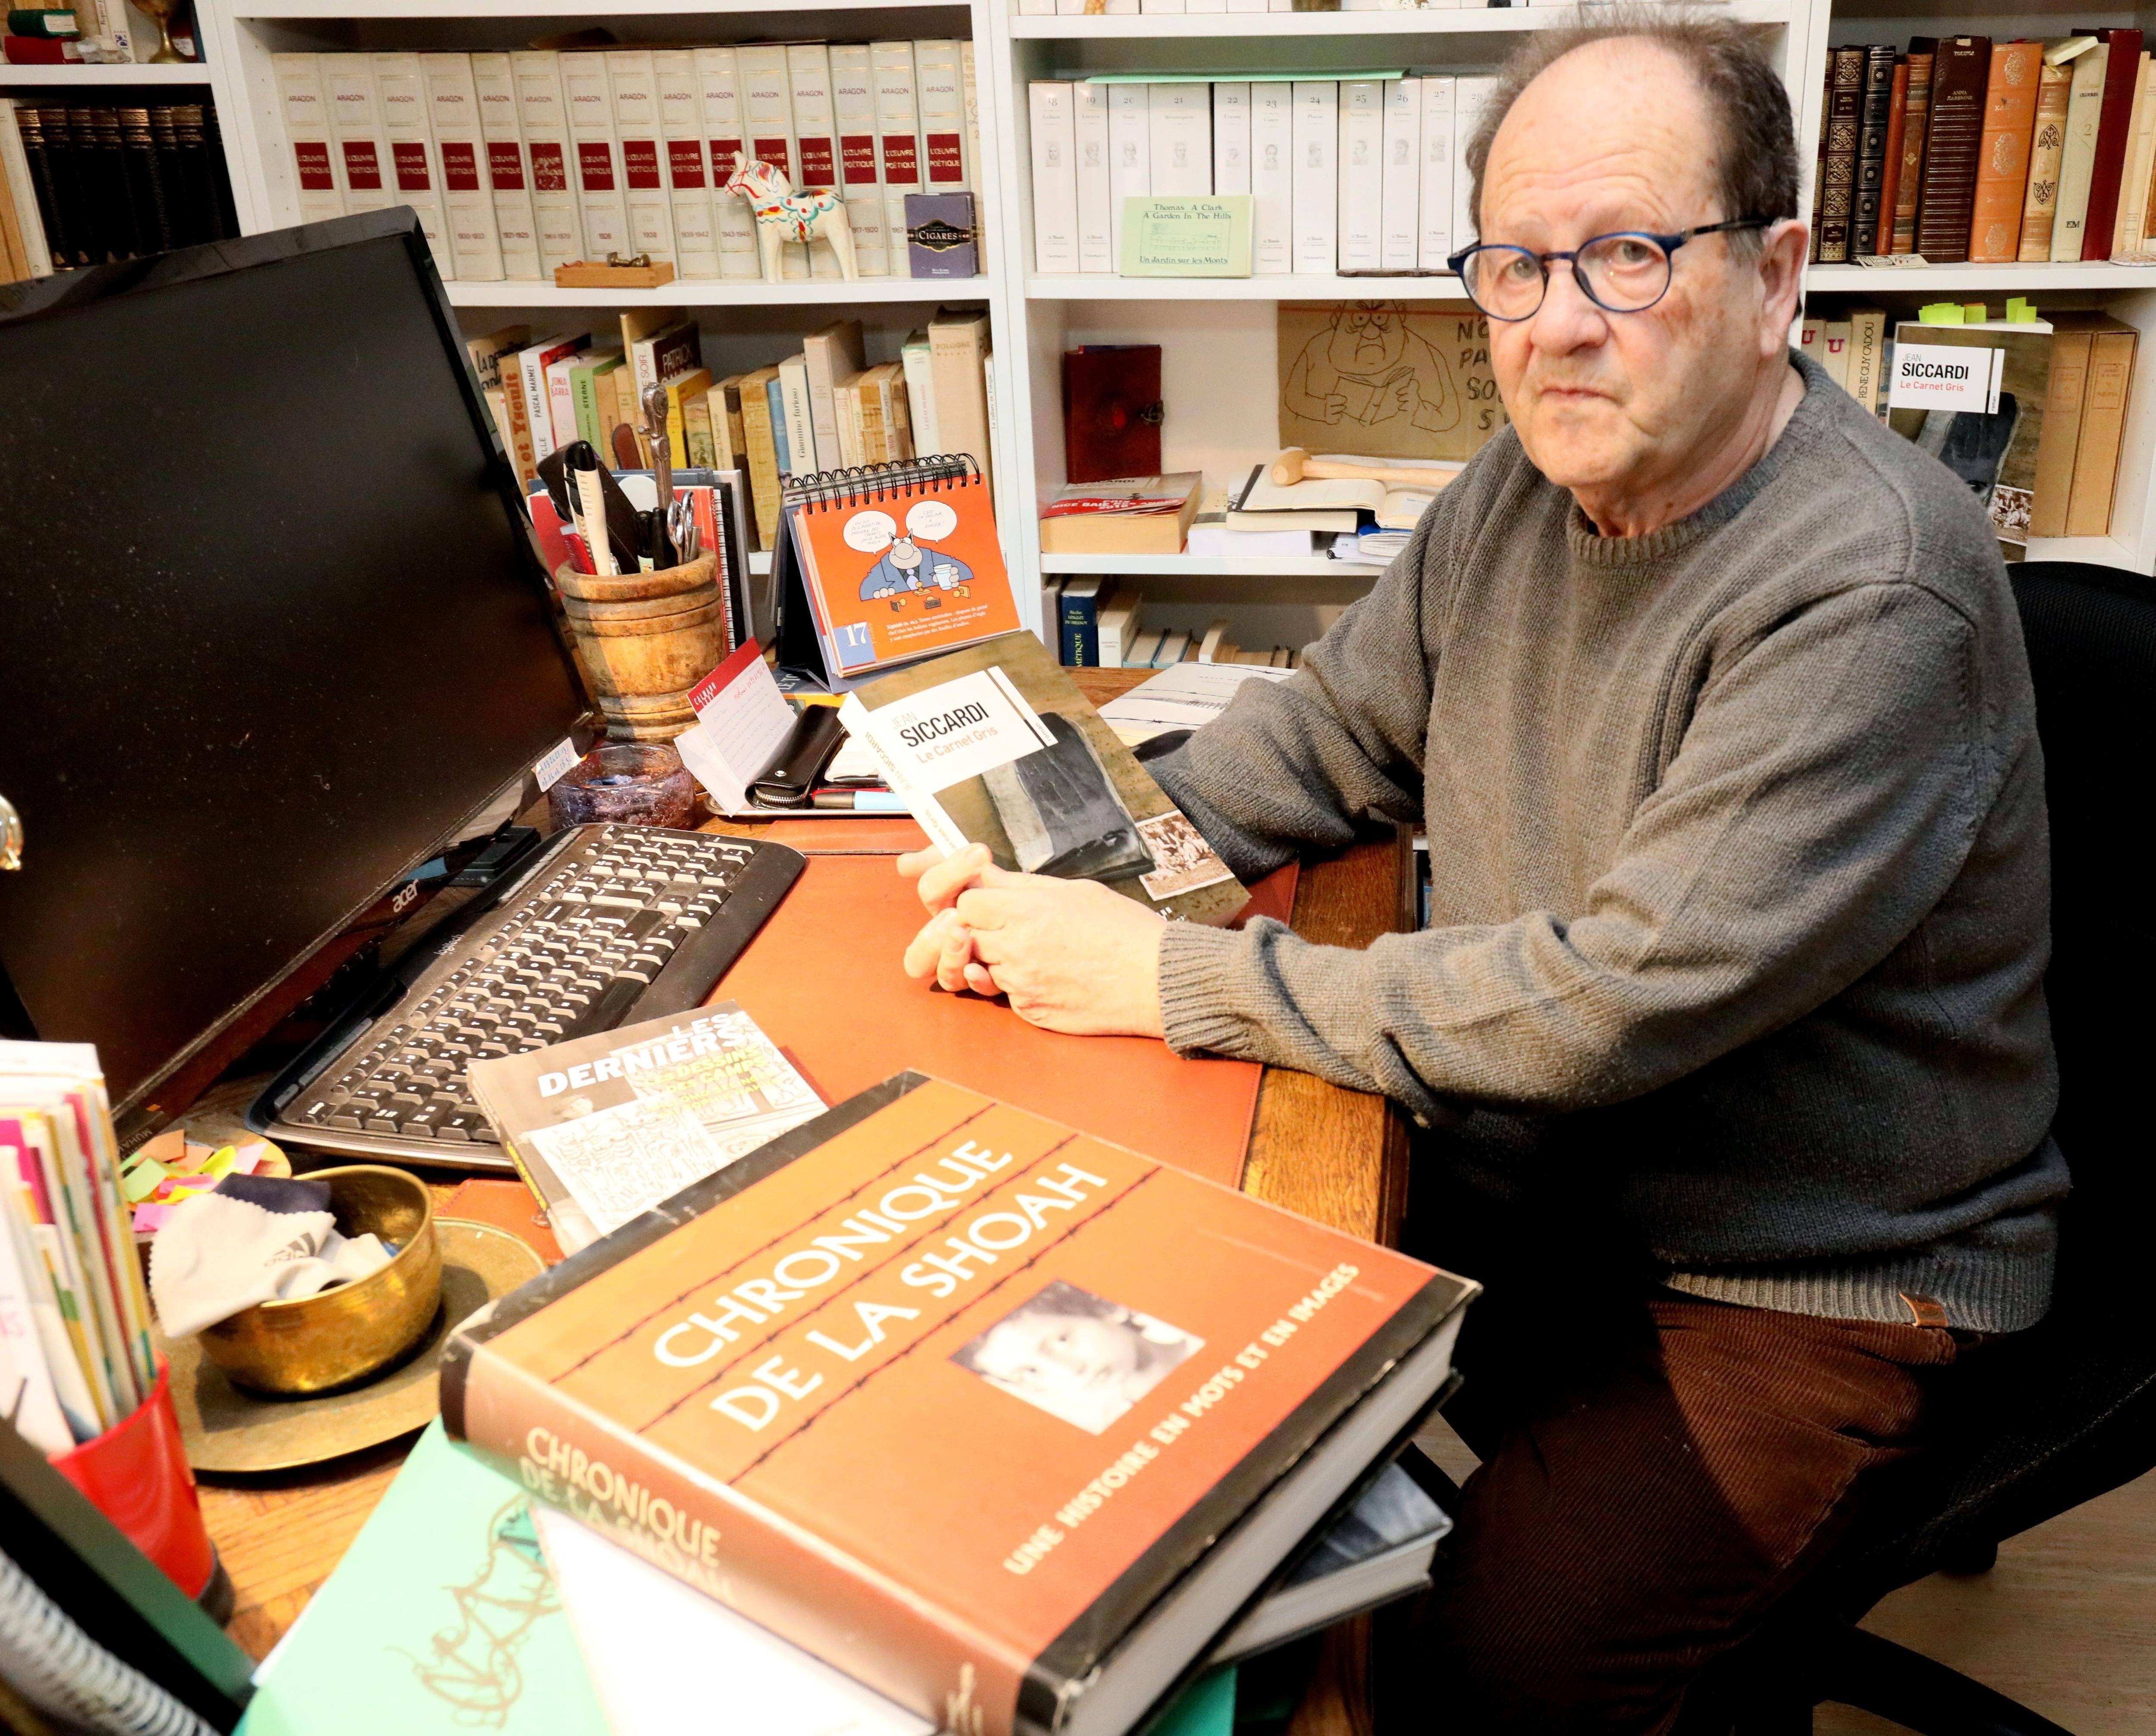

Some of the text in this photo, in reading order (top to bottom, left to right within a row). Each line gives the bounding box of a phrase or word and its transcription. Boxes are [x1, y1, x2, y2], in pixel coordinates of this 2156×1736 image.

[1048, 97, 1057, 106] 18
[1266, 100, 1277, 108] 23
[1310, 97, 1320, 105] 24
[1356, 95, 1366, 104] 25
[1397, 94, 1408, 103] 26
[1434, 91, 1445, 100] 27
[1471, 94, 1482, 102] 28
[919, 230, 958, 240] CIGARES
[936, 341, 970, 350] POLOGNE
[1802, 330, 1816, 345] U
[1828, 339, 1845, 353] U
[1862, 322, 1874, 355] CADOU
[1459, 348, 1487, 370] PA
[1860, 357, 1871, 376] GUY
[1902, 353, 1921, 362] JEAN
[1902, 362, 1969, 380] SICCARDI
[527, 364, 542, 418] PASCAL MARMET
[580, 379, 589, 409] STERNE
[1900, 380, 1964, 392] Le Carnet Gris
[792, 388, 806, 458] Giannino furioso
[844, 622, 868, 647] 17
[892, 711, 918, 730] JEAN
[899, 702, 990, 747] SICCARDI
[1035, 722, 1052, 742] roman
[865, 732, 896, 772] SICCARDI
[916, 724, 999, 764] Le Carnet Gris
[392, 878, 420, 913] acer
[433, 934, 465, 956] logitech
[671, 1012, 733, 1037] LES
[537, 1024, 745, 1098] DERNIERS
[676, 1045, 760, 1078] DESSINS
[666, 1080, 698, 1094] DES
[702, 1056, 767, 1083] CAMPS
[653, 1140, 1014, 1367] CHRONIQUE
[708, 1163, 1109, 1433] DE LA SHOAH
[1003, 1262, 1360, 1576] UNE HISTOIRE EN MOTS ET EN IMAGES
[519, 1456, 559, 1502] DE
[567, 1485, 606, 1528] LA
[526, 1426, 721, 1569] CHRONIQUE
